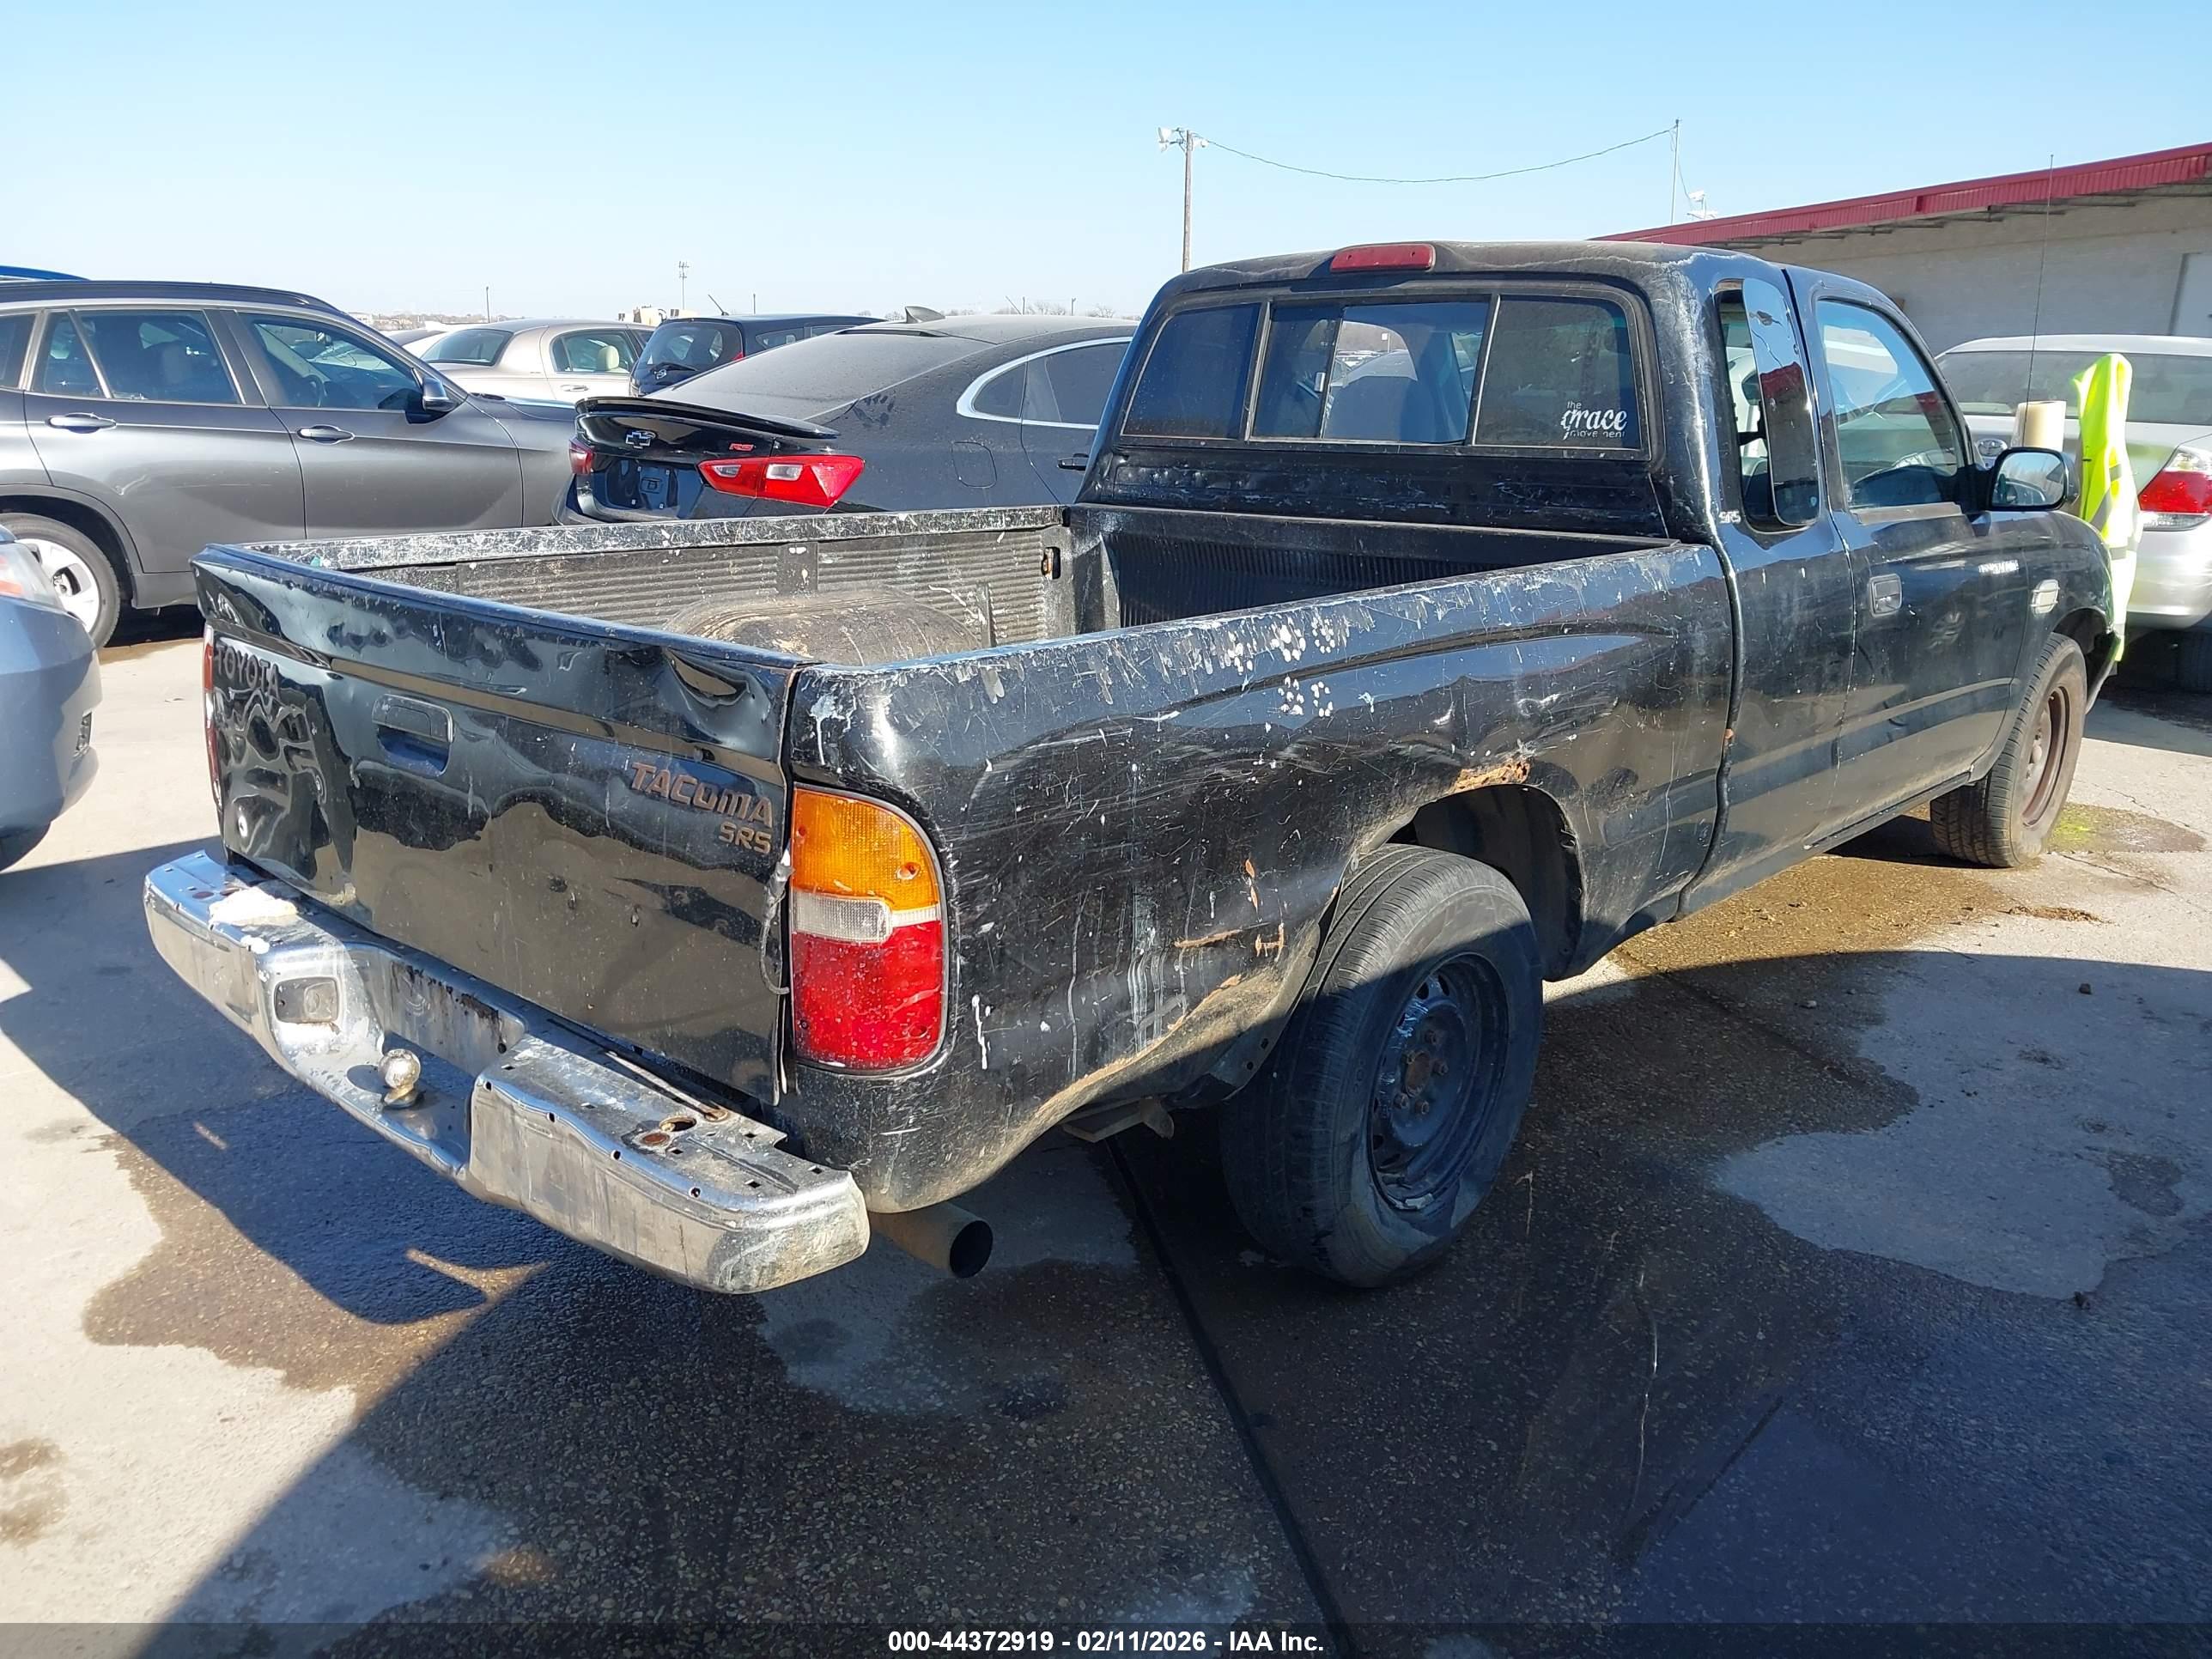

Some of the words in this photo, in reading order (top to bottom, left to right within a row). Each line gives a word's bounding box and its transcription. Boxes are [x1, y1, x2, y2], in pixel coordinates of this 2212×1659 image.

[1560, 409, 1627, 440] grace
[1566, 400, 1582, 410] the
[216, 641, 280, 700] TOYOTA
[631, 762, 773, 829] TACOMA
